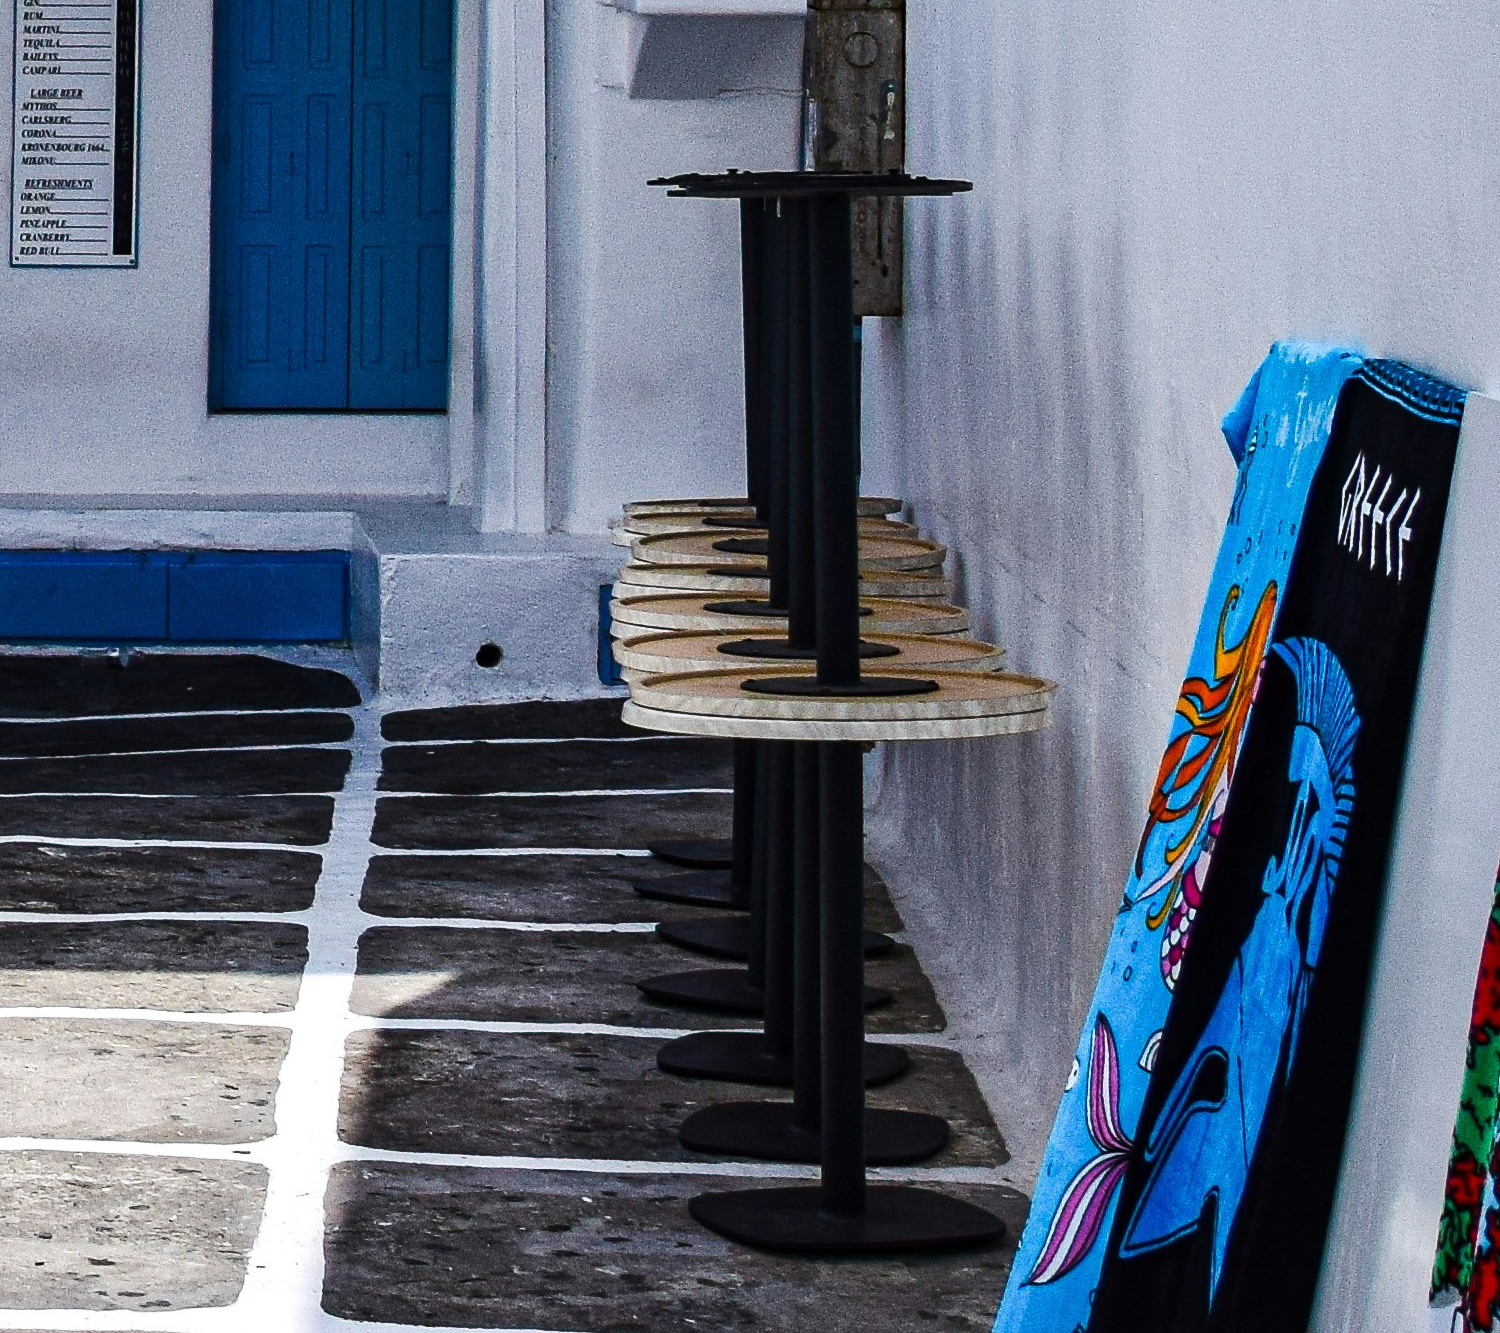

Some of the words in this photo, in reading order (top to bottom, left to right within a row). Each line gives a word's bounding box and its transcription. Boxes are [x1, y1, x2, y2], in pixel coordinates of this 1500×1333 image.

[23, 12, 44, 21] RUM
[23, 25, 60, 34] MARTINI
[23, 39, 60, 49] TEQUILA
[22, 115, 72, 124] CARLSBERG
[21, 129, 56, 138] CORONA
[25, 179, 93, 188] REFRESHMENTS
[20, 192, 56, 201] ORANGE
[20, 206, 50, 214] LEMON
[20, 219, 67, 228] PINEAPPLE
[19, 233, 71, 242] CRANBERRY
[19, 246, 38, 255] RED
[39, 246, 61, 255] BULL
